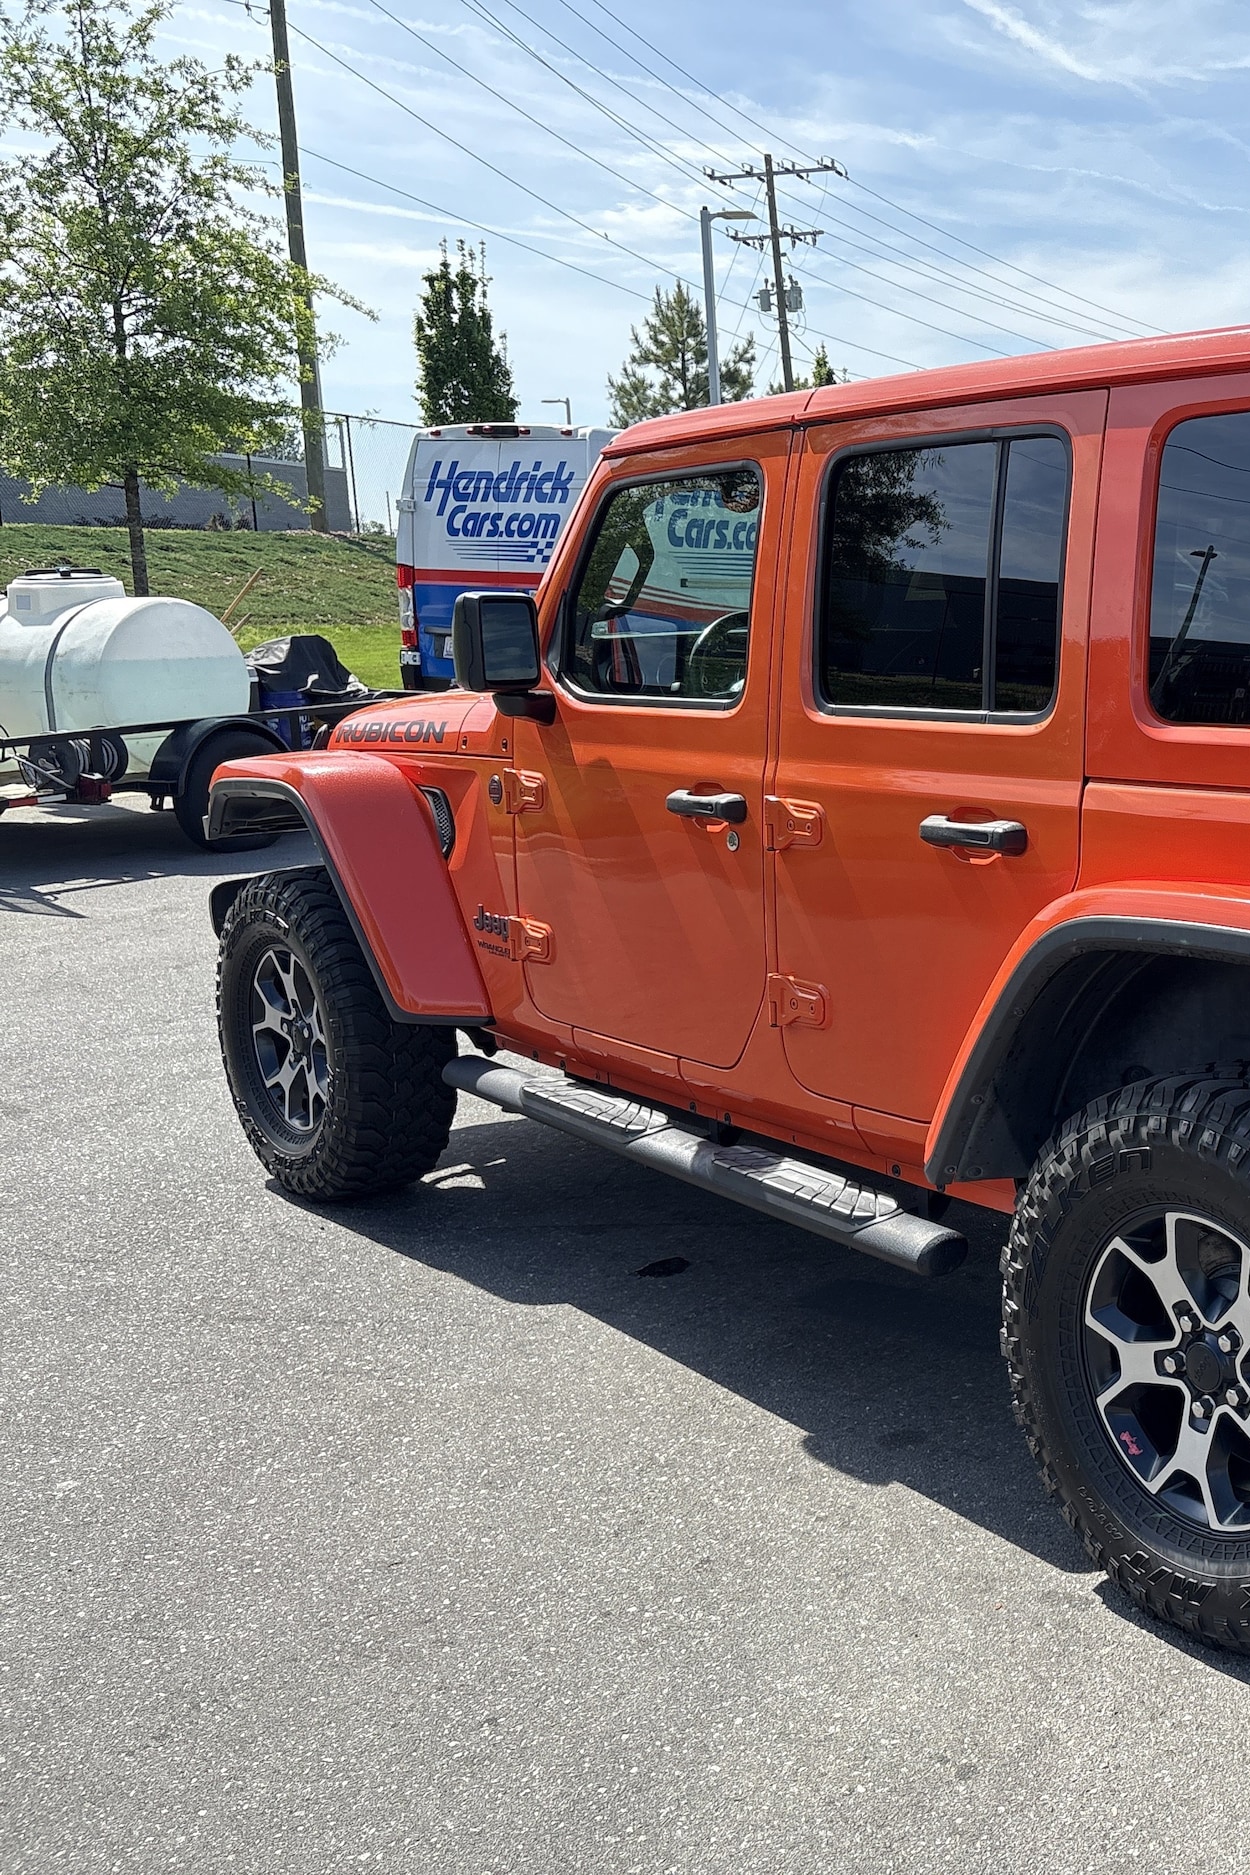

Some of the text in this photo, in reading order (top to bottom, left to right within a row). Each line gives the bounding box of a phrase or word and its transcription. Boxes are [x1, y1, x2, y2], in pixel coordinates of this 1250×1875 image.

[424, 460, 575, 516] Hendrick
[446, 504, 561, 539] Cars.com
[335, 720, 448, 743] RUBICON
[473, 903, 509, 943] Jeep
[477, 940, 511, 954] WRANGLE
